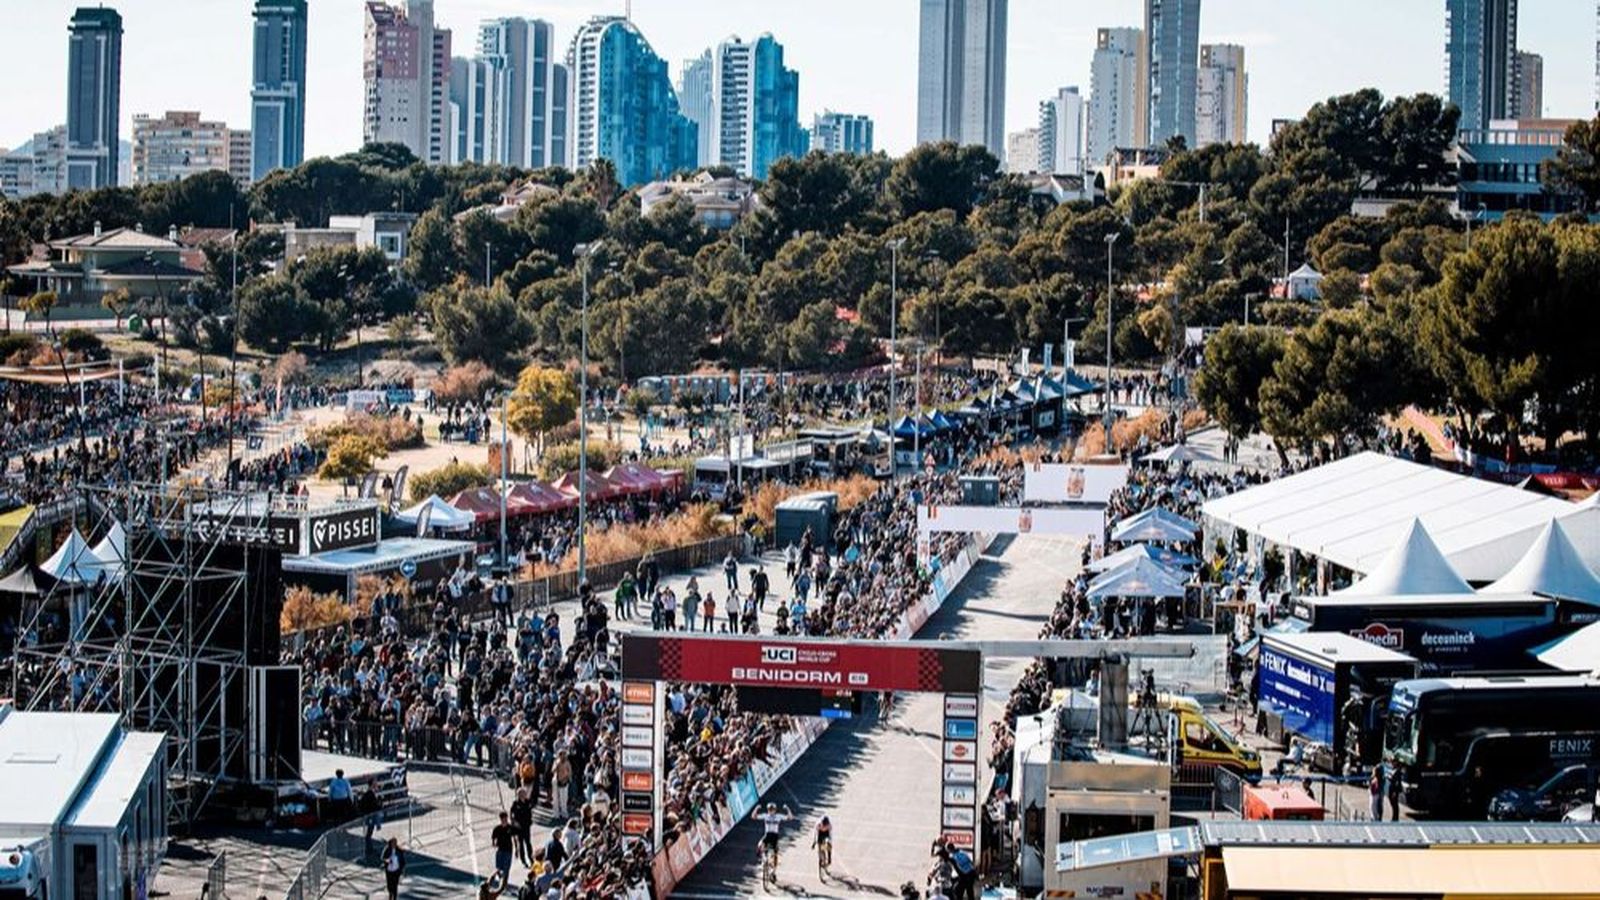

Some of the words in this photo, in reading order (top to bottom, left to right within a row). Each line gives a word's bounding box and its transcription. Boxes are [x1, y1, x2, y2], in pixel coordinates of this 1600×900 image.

[328, 517, 375, 543] PISSEI
[767, 649, 794, 661] UCI
[731, 667, 842, 684] BENIDORM
[1549, 740, 1592, 753] FENIX
